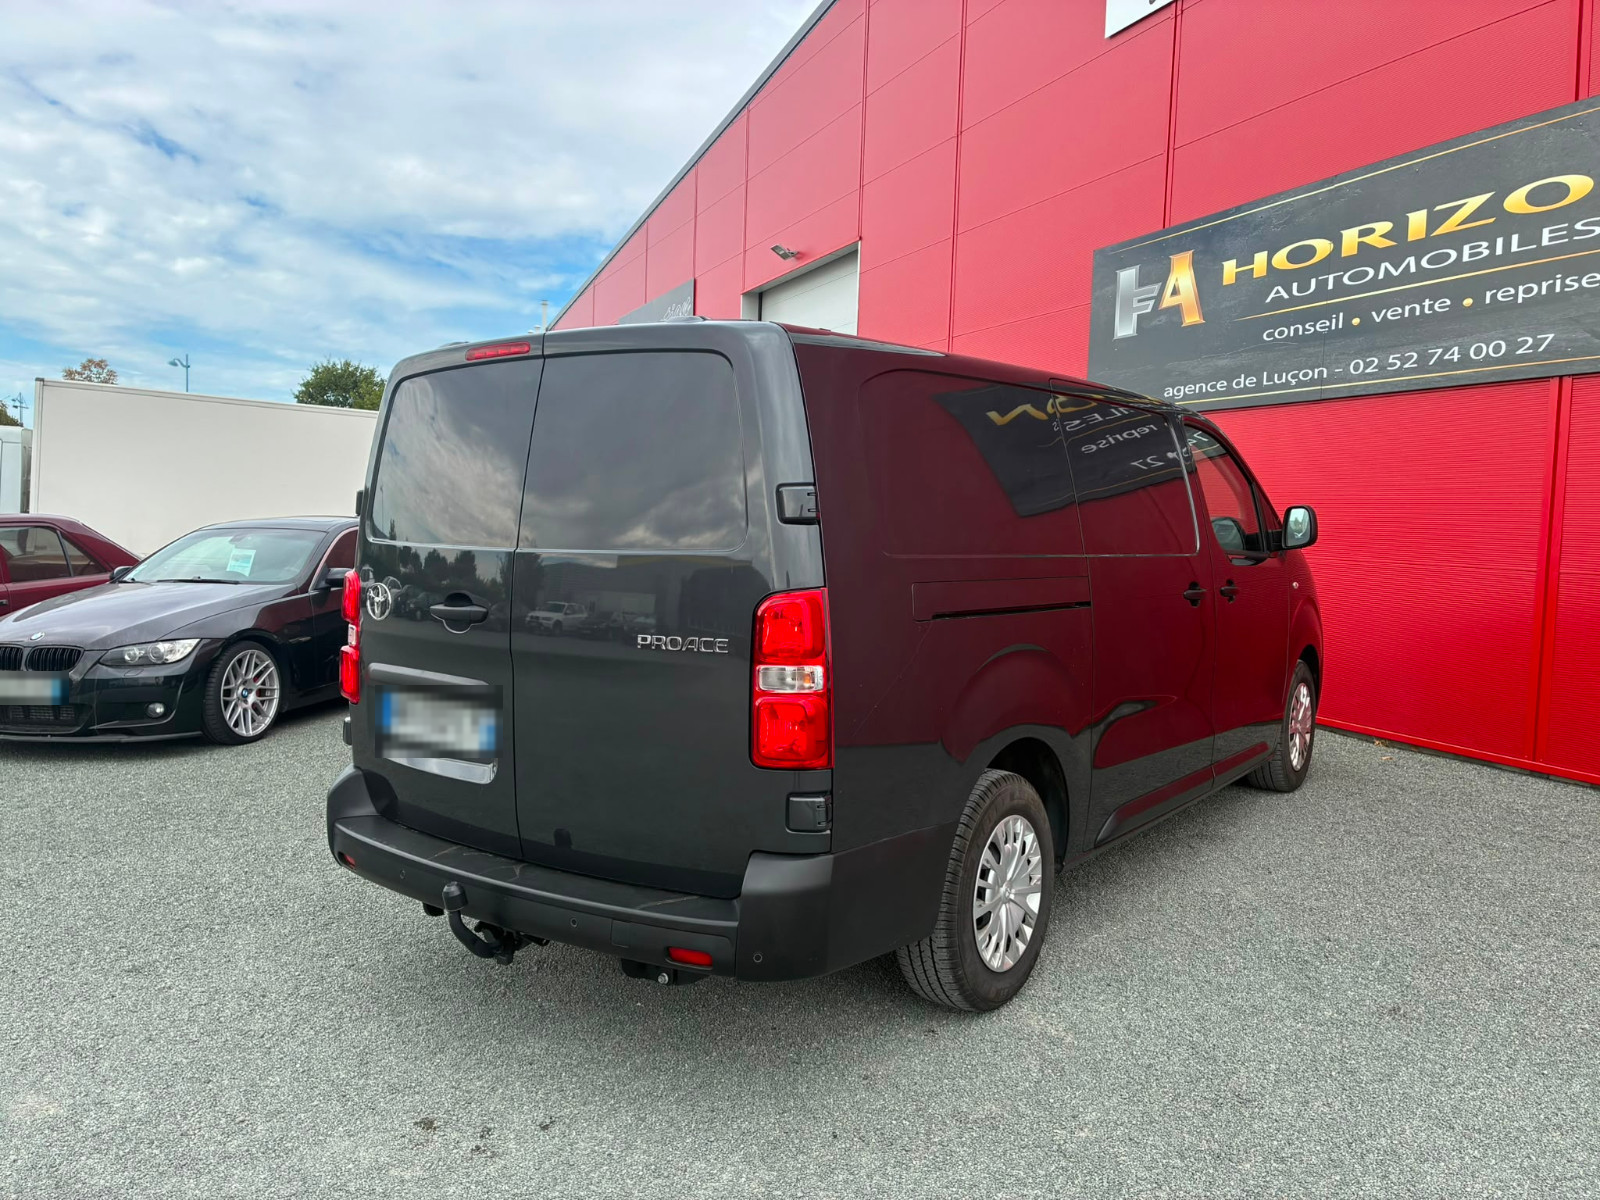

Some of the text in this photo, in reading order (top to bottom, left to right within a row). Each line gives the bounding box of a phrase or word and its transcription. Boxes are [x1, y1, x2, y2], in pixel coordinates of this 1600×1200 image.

[1264, 216, 1600, 303] AUTOMOBILES
[1262, 272, 1600, 341] conseil vente reprise
[1164, 379, 1227, 399] agence
[1232, 374, 1257, 389] de
[1263, 367, 1327, 386] Luçon
[1349, 357, 1379, 375] 02
[1386, 352, 1418, 370] 52
[1427, 346, 1461, 365] 74
[1469, 340, 1506, 360] 00
[1515, 333, 1555, 355] 27
[637, 634, 729, 653] PROACE
